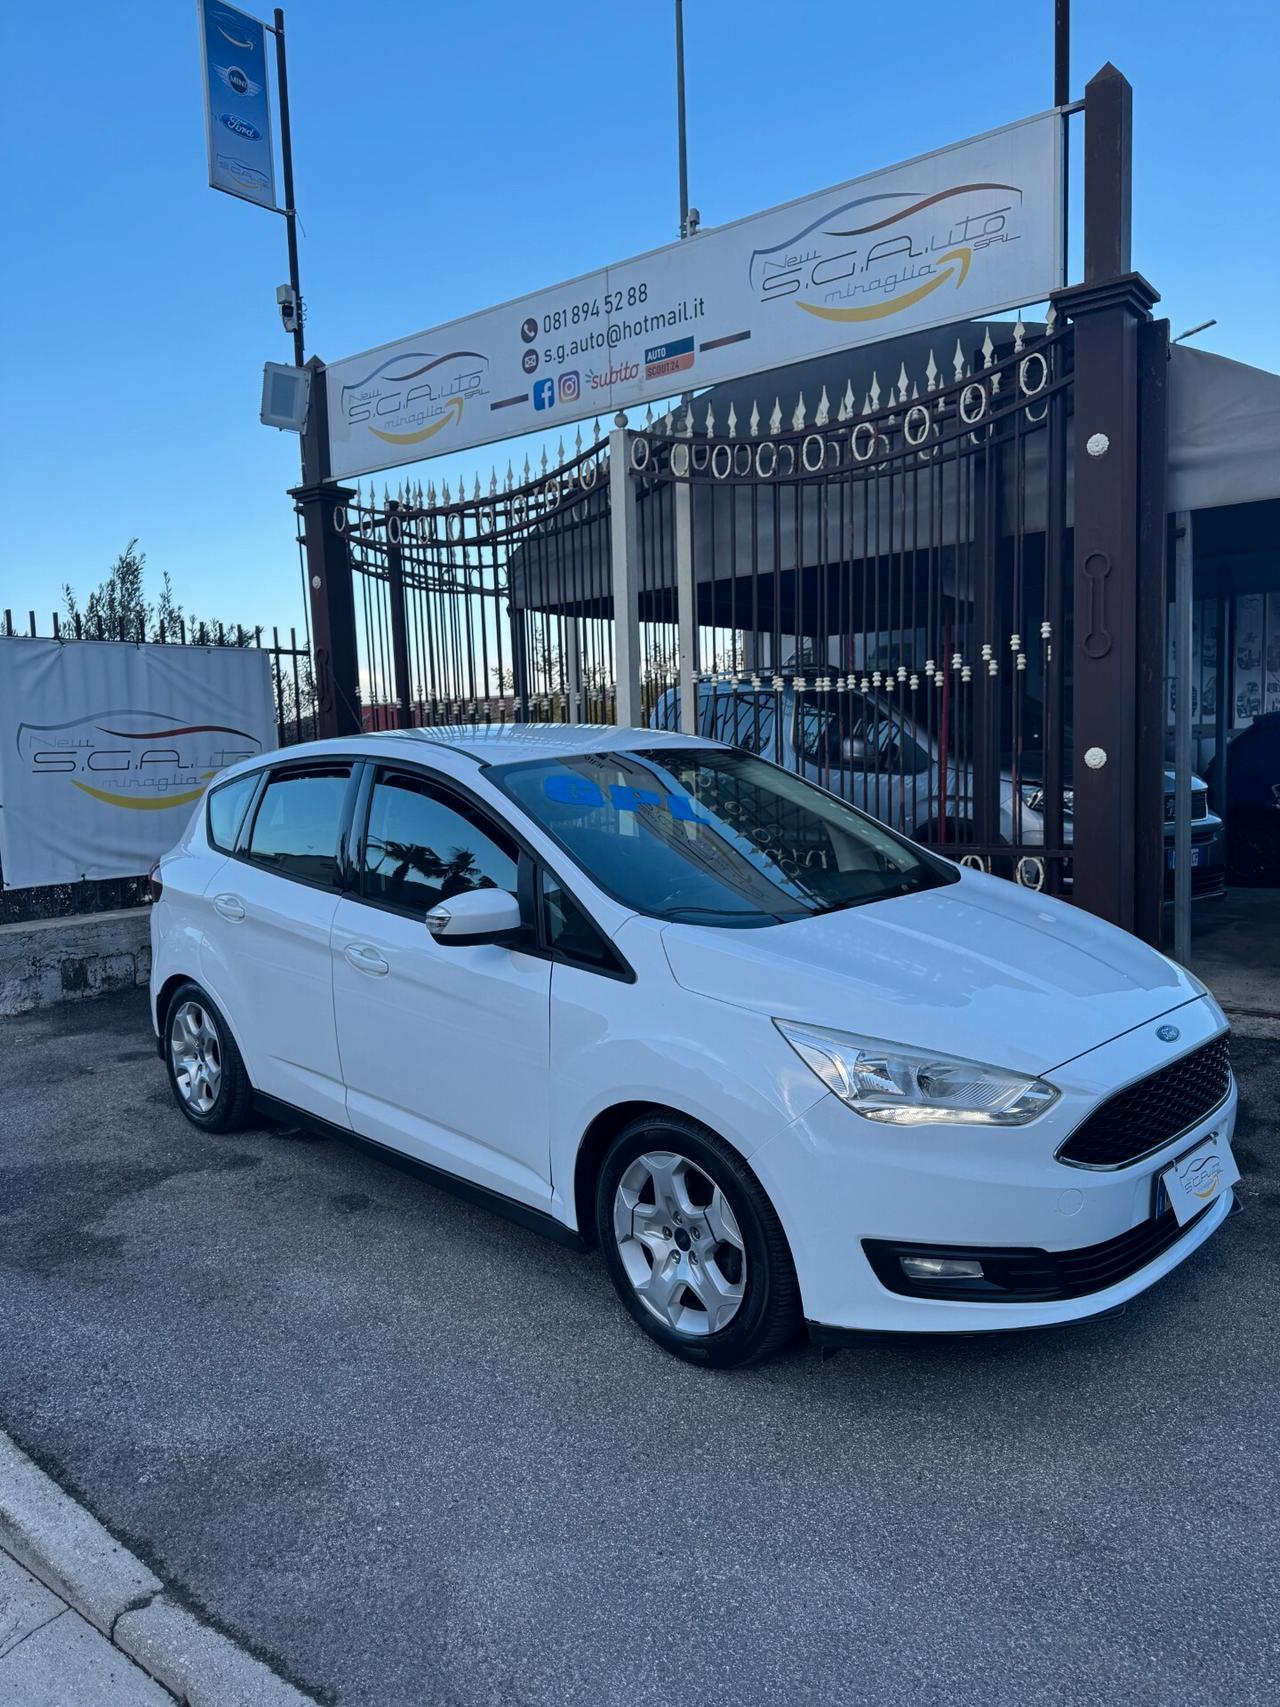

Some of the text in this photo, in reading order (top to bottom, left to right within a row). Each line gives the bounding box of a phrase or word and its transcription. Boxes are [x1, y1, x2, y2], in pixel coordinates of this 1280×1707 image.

[228, 115, 255, 138] Ford
[762, 249, 822, 275] New
[824, 263, 938, 303] miraglia
[543, 283, 648, 334] 081 894 52 88
[544, 297, 705, 365] s.g.auto@hotmail.it
[647, 346, 667, 362] AUTO
[591, 361, 640, 390] subito
[102, 773, 202, 792] miraglia
